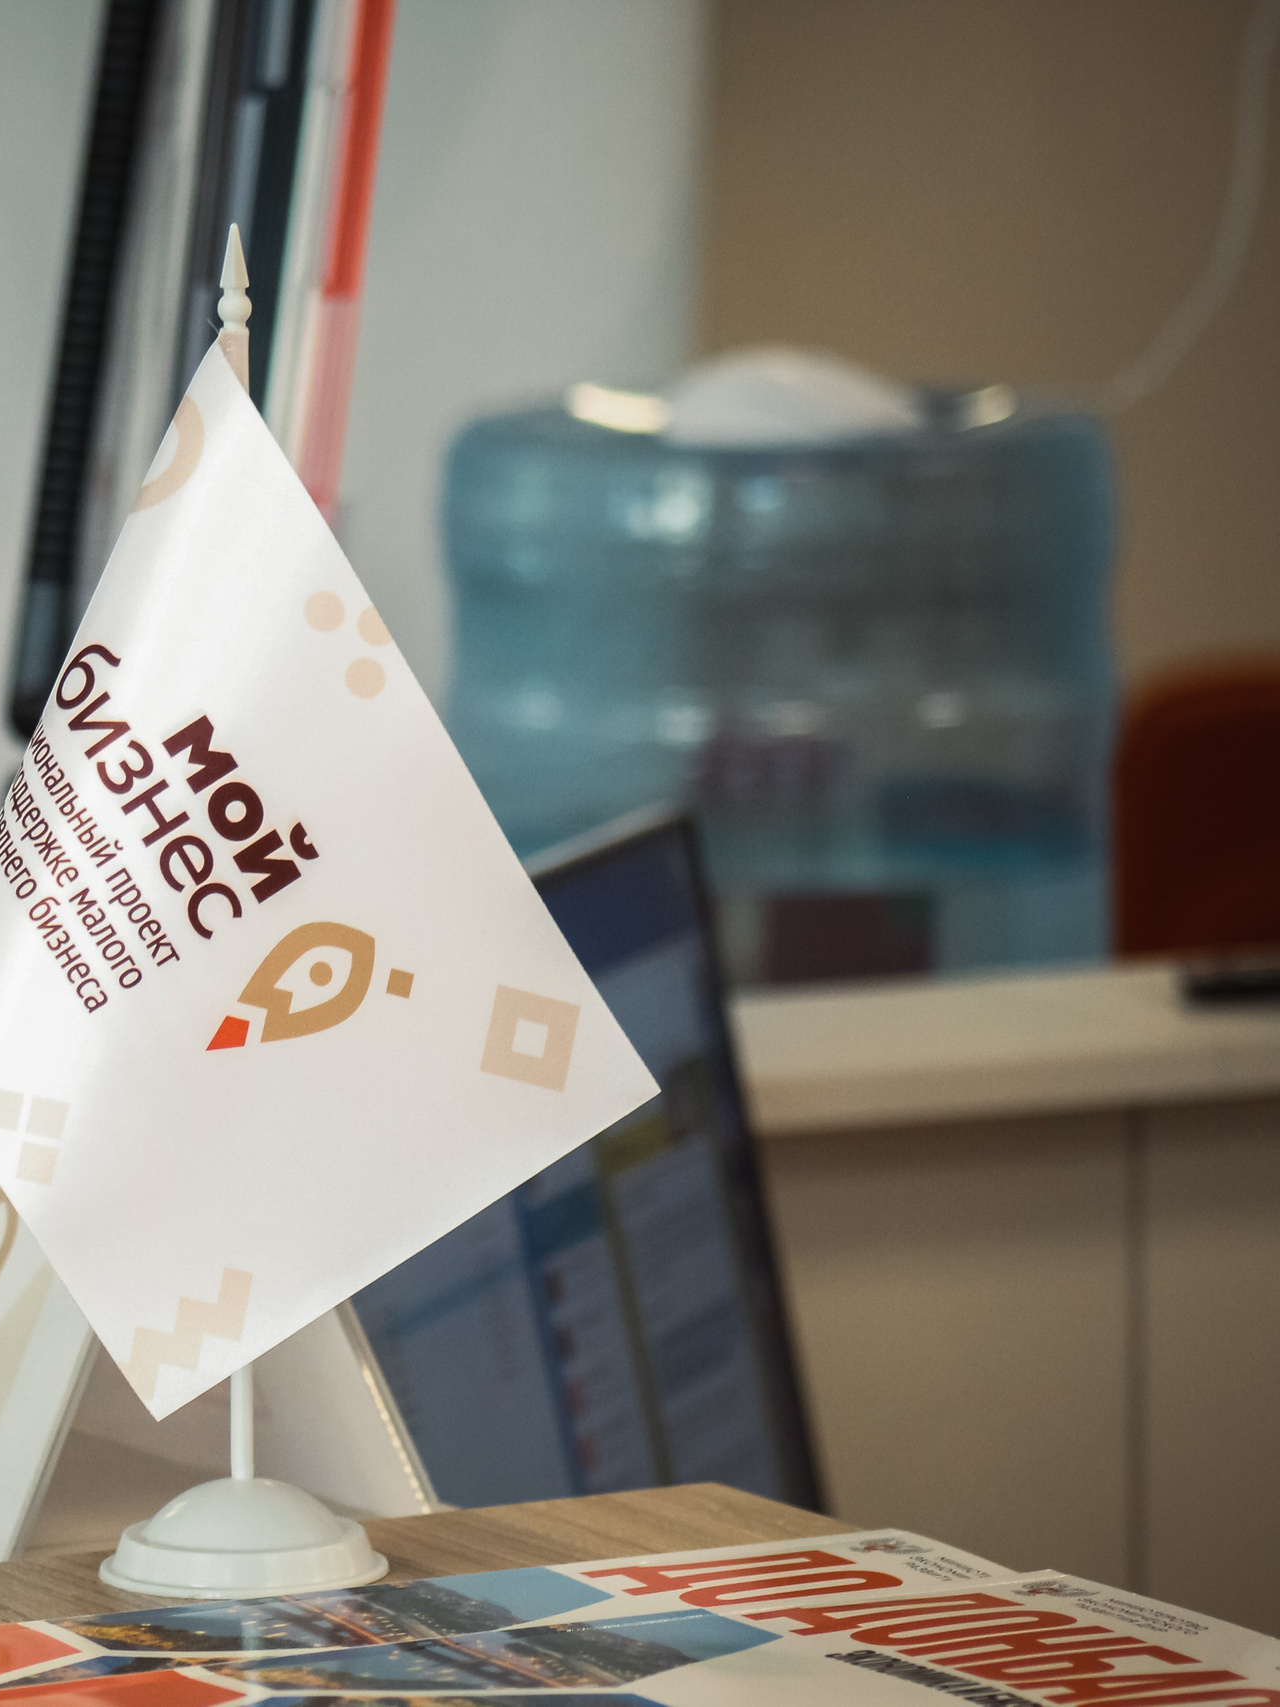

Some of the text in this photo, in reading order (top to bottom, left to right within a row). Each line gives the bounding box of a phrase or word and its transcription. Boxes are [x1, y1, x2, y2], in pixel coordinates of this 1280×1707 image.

[55, 643, 243, 940] бизнес
[162, 714, 319, 904] мой
[28, 896, 109, 1014] бизнеса
[68, 887, 143, 990] малого
[104, 867, 181, 968] проект
